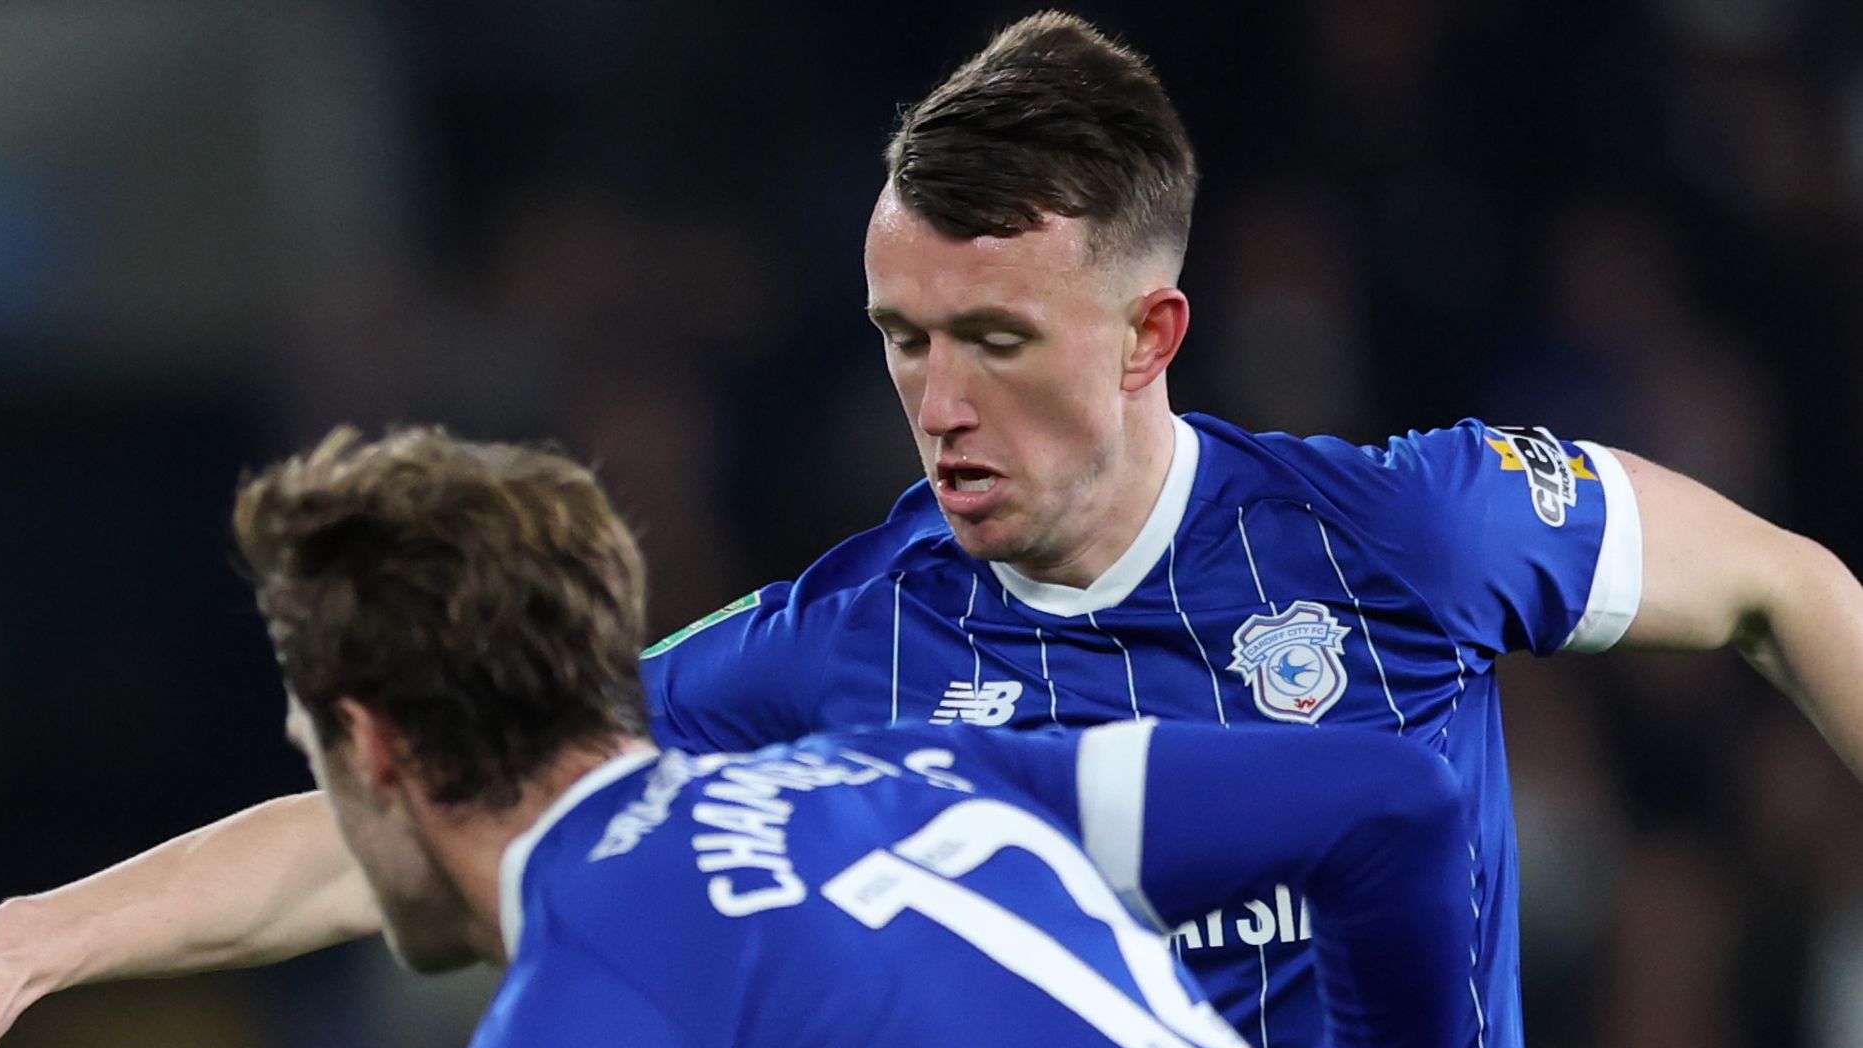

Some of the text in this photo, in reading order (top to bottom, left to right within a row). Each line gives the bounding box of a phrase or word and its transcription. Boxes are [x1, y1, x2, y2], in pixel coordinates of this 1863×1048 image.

[1246, 626, 1325, 656] CARDIFF CITY FC
